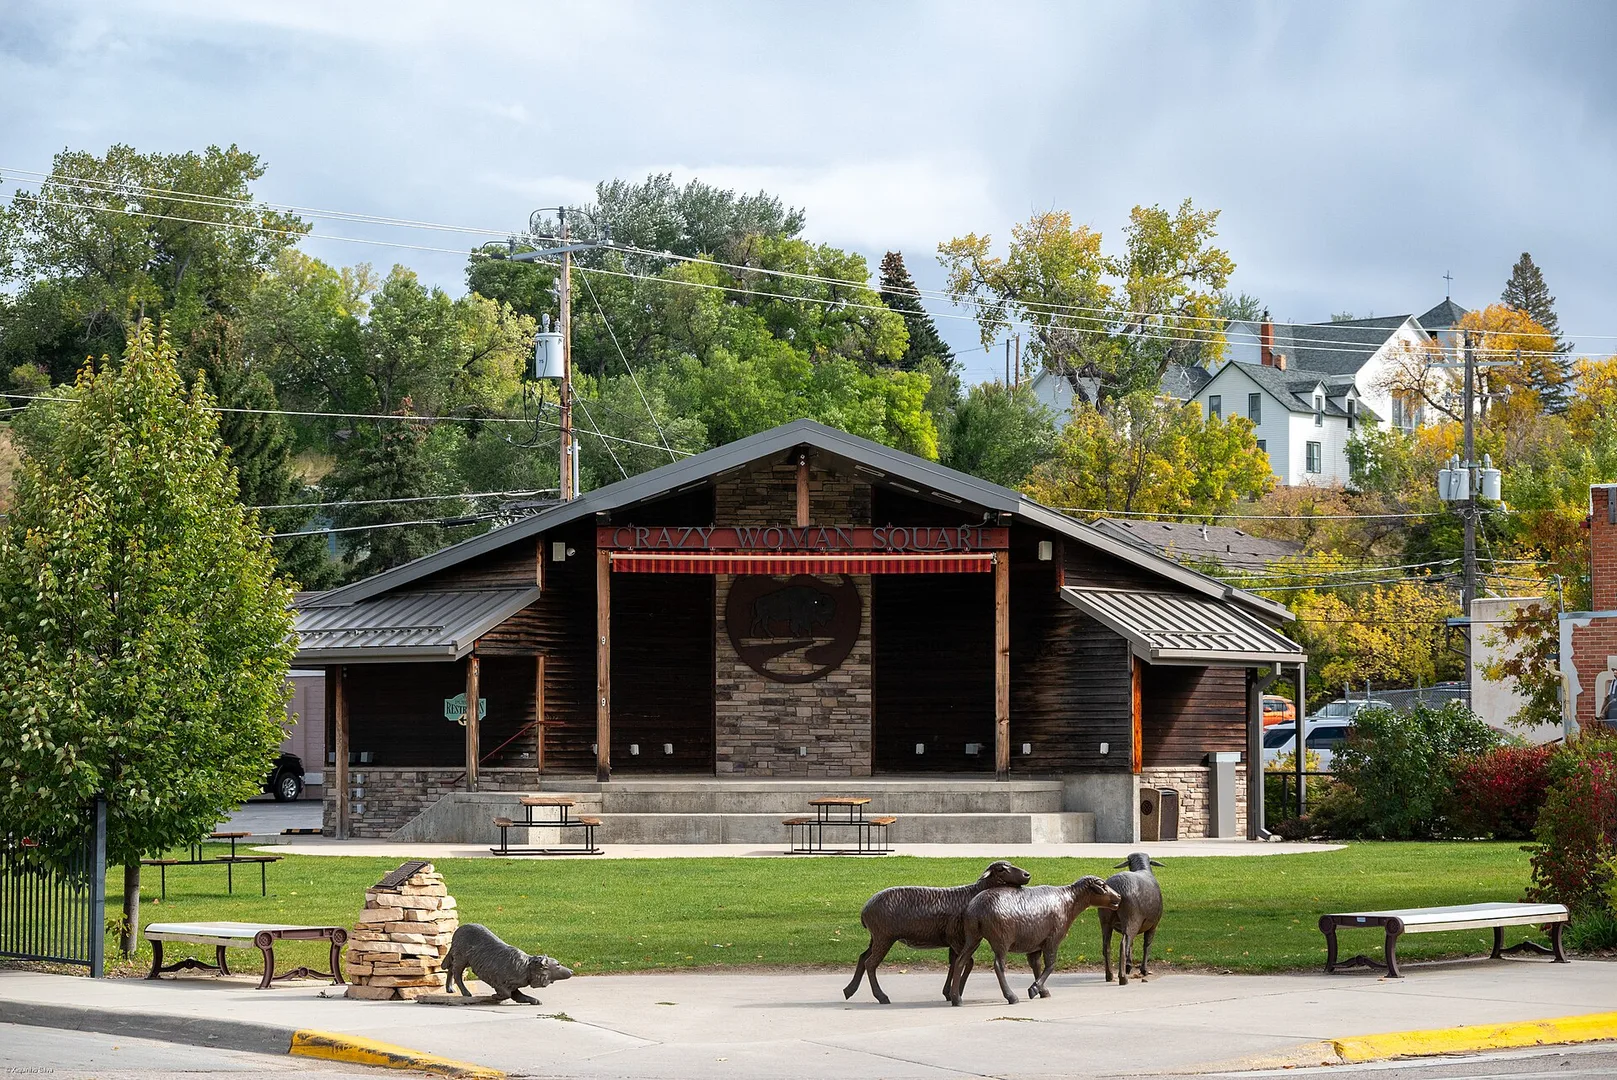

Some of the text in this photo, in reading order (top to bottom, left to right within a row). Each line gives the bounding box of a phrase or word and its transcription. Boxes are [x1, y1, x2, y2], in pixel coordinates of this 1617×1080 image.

[612, 526, 992, 552] CRAZY WOMAN SQUARE
[446, 701, 484, 714] RESTRS
